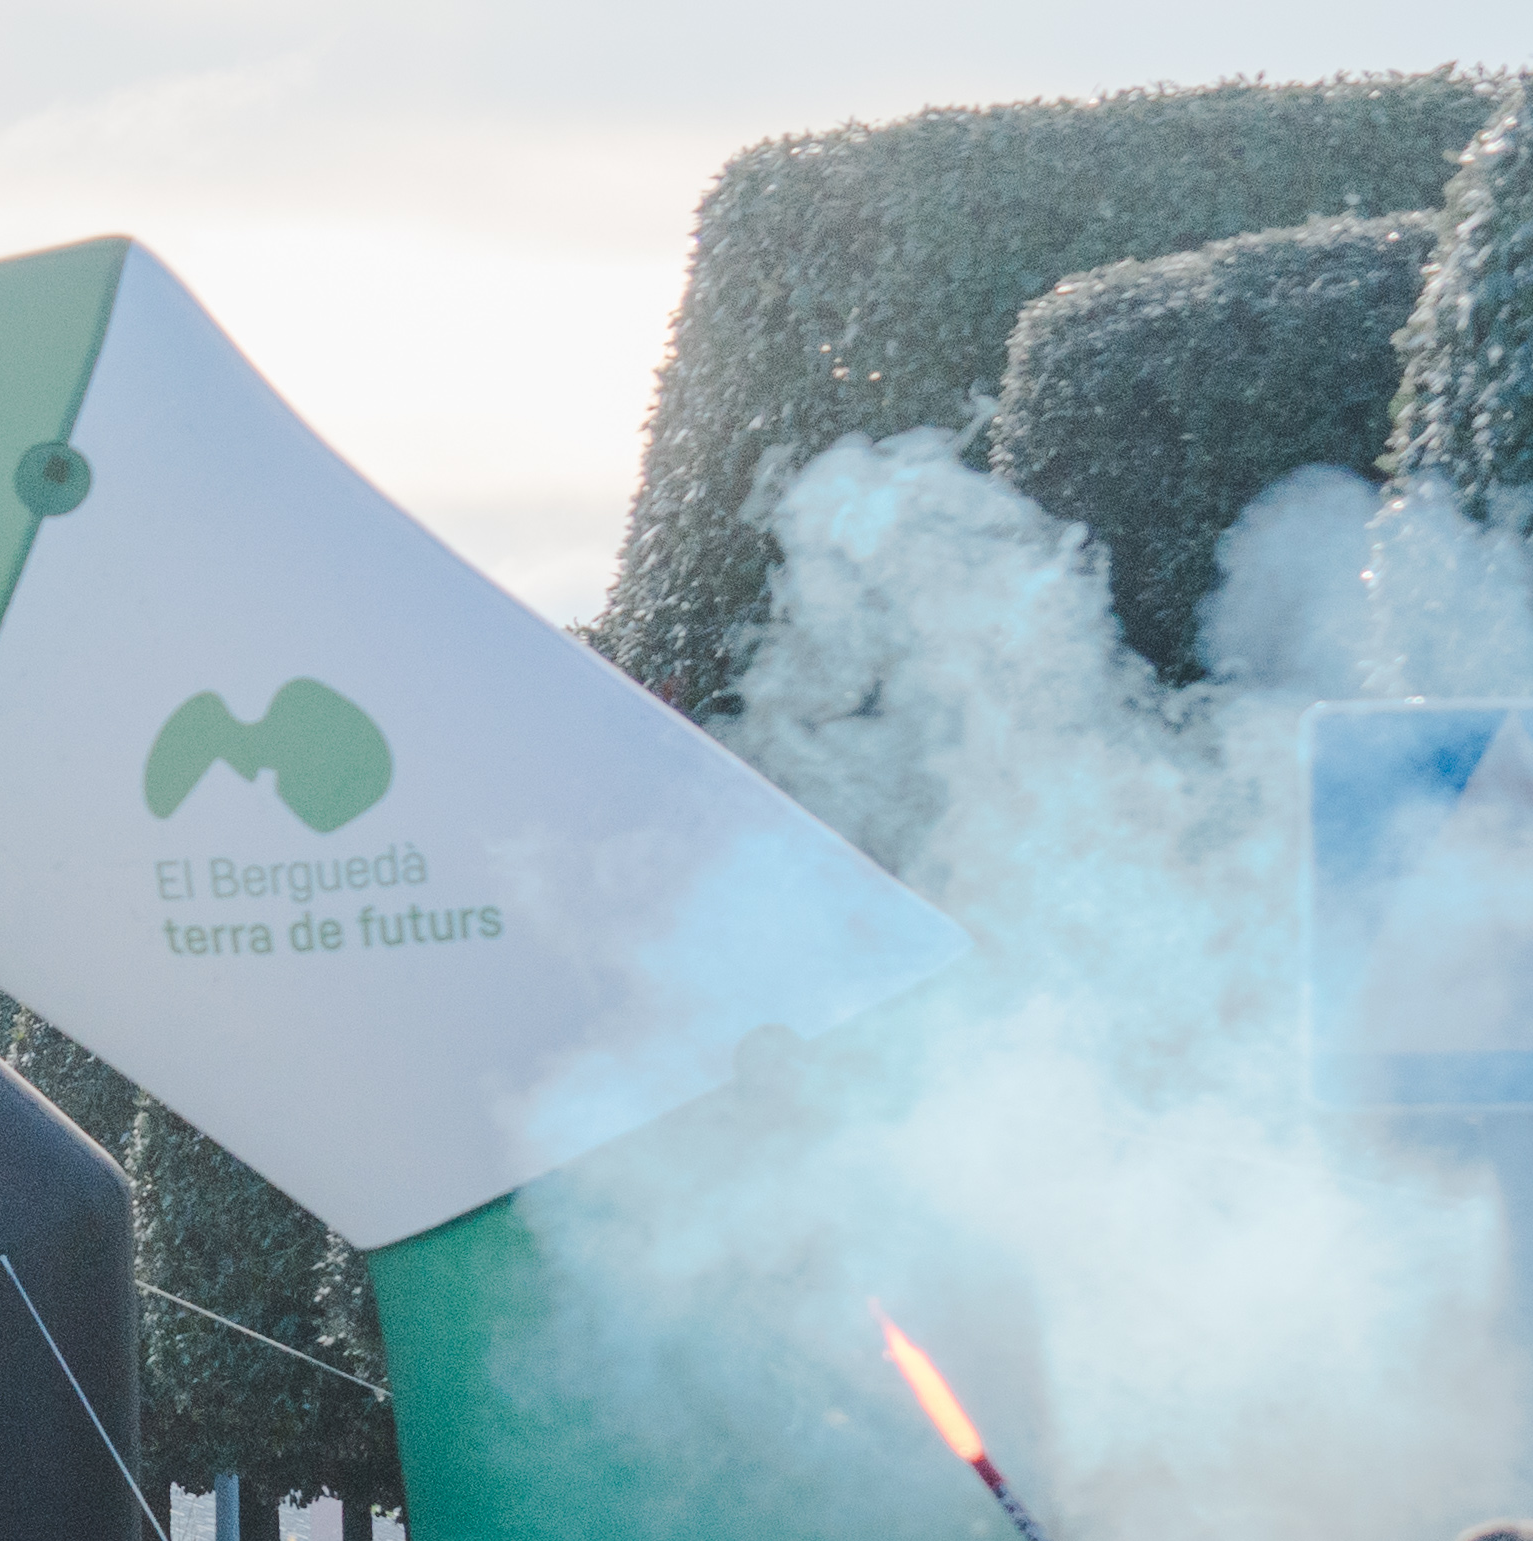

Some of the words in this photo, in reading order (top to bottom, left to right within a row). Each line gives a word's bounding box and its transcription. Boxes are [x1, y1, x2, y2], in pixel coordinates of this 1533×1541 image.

[155, 859, 195, 901] El
[209, 842, 428, 904] Berguedà
[164, 918, 274, 955] terra
[289, 911, 344, 953] de
[358, 904, 504, 948] futurs
